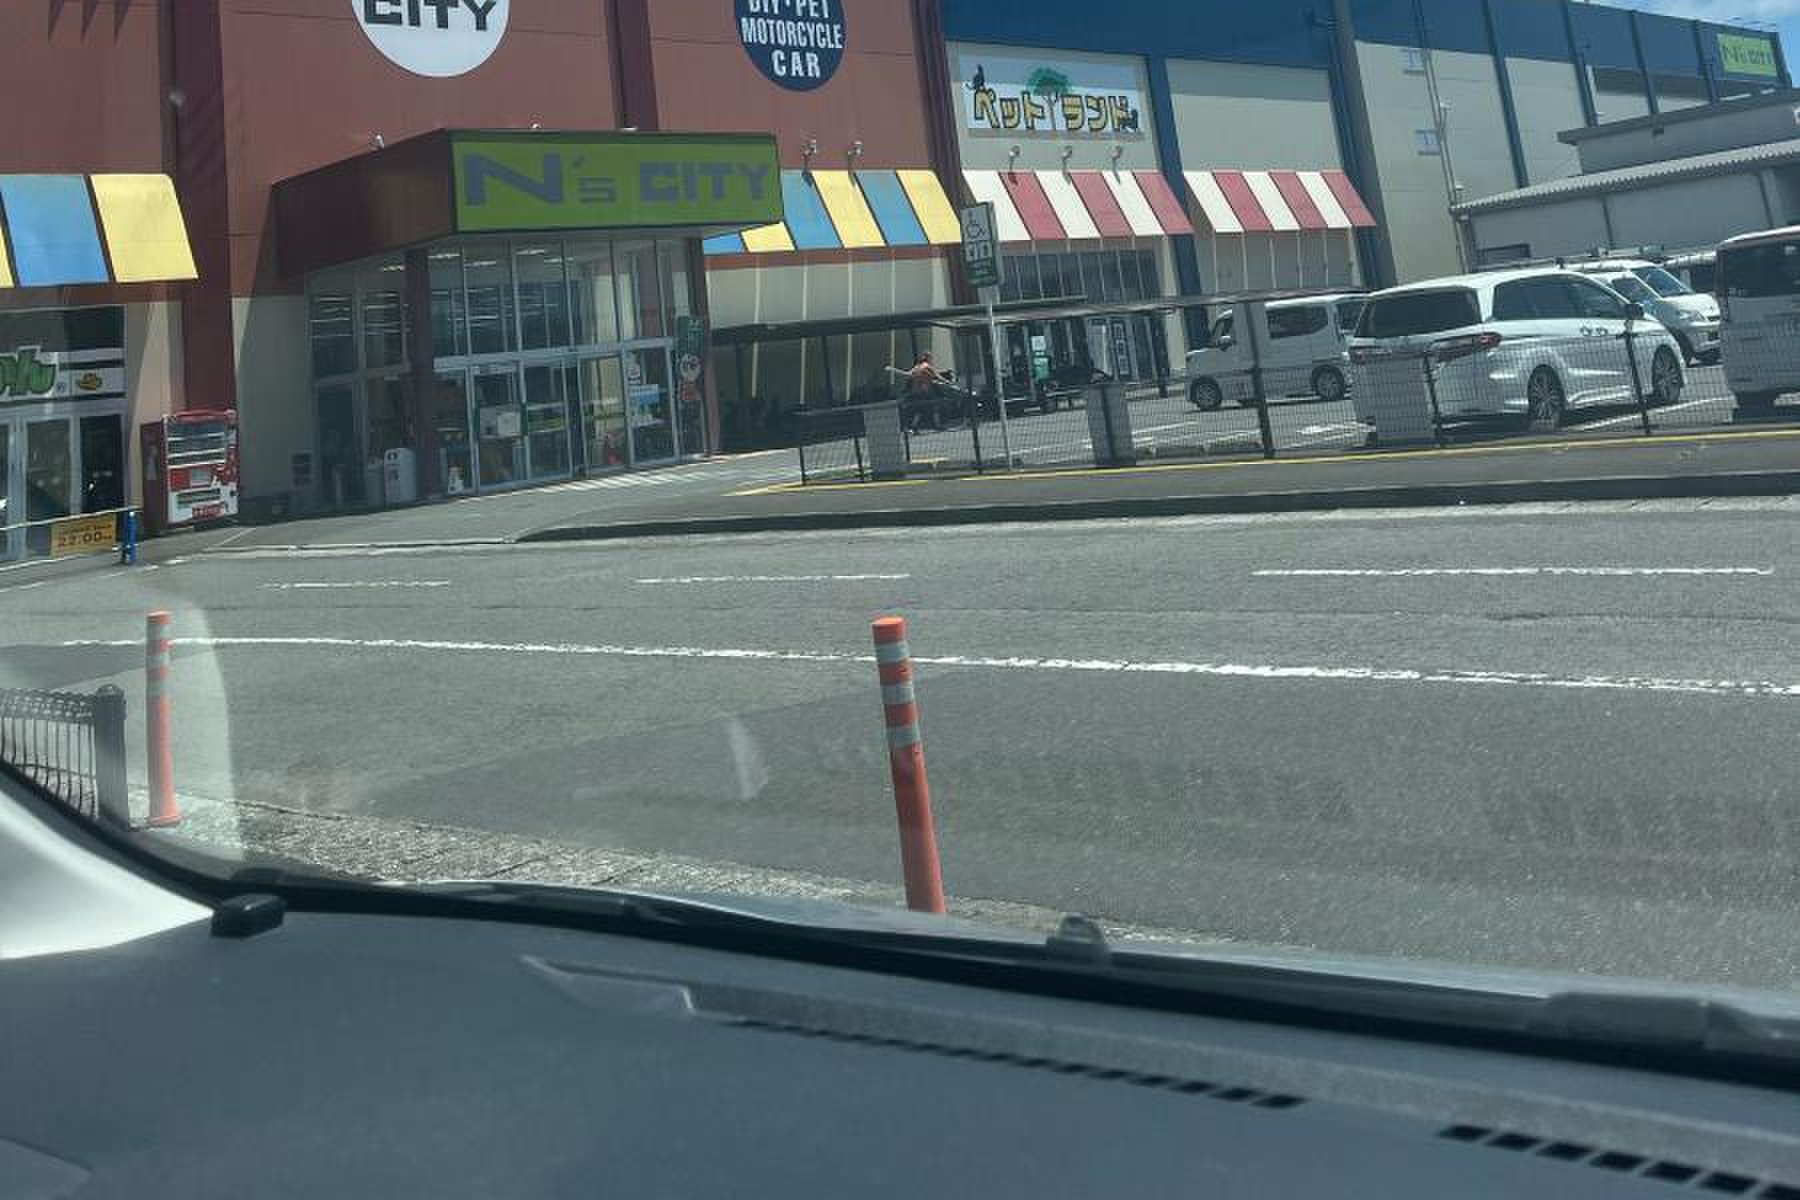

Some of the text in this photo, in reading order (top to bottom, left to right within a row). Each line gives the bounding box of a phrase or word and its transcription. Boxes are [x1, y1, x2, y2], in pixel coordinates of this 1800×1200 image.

[741, 17, 843, 49] MOTORCYCLE
[771, 49, 821, 78] CAR
[974, 87, 1132, 131] ペットランド
[462, 152, 769, 205] N's CITY
